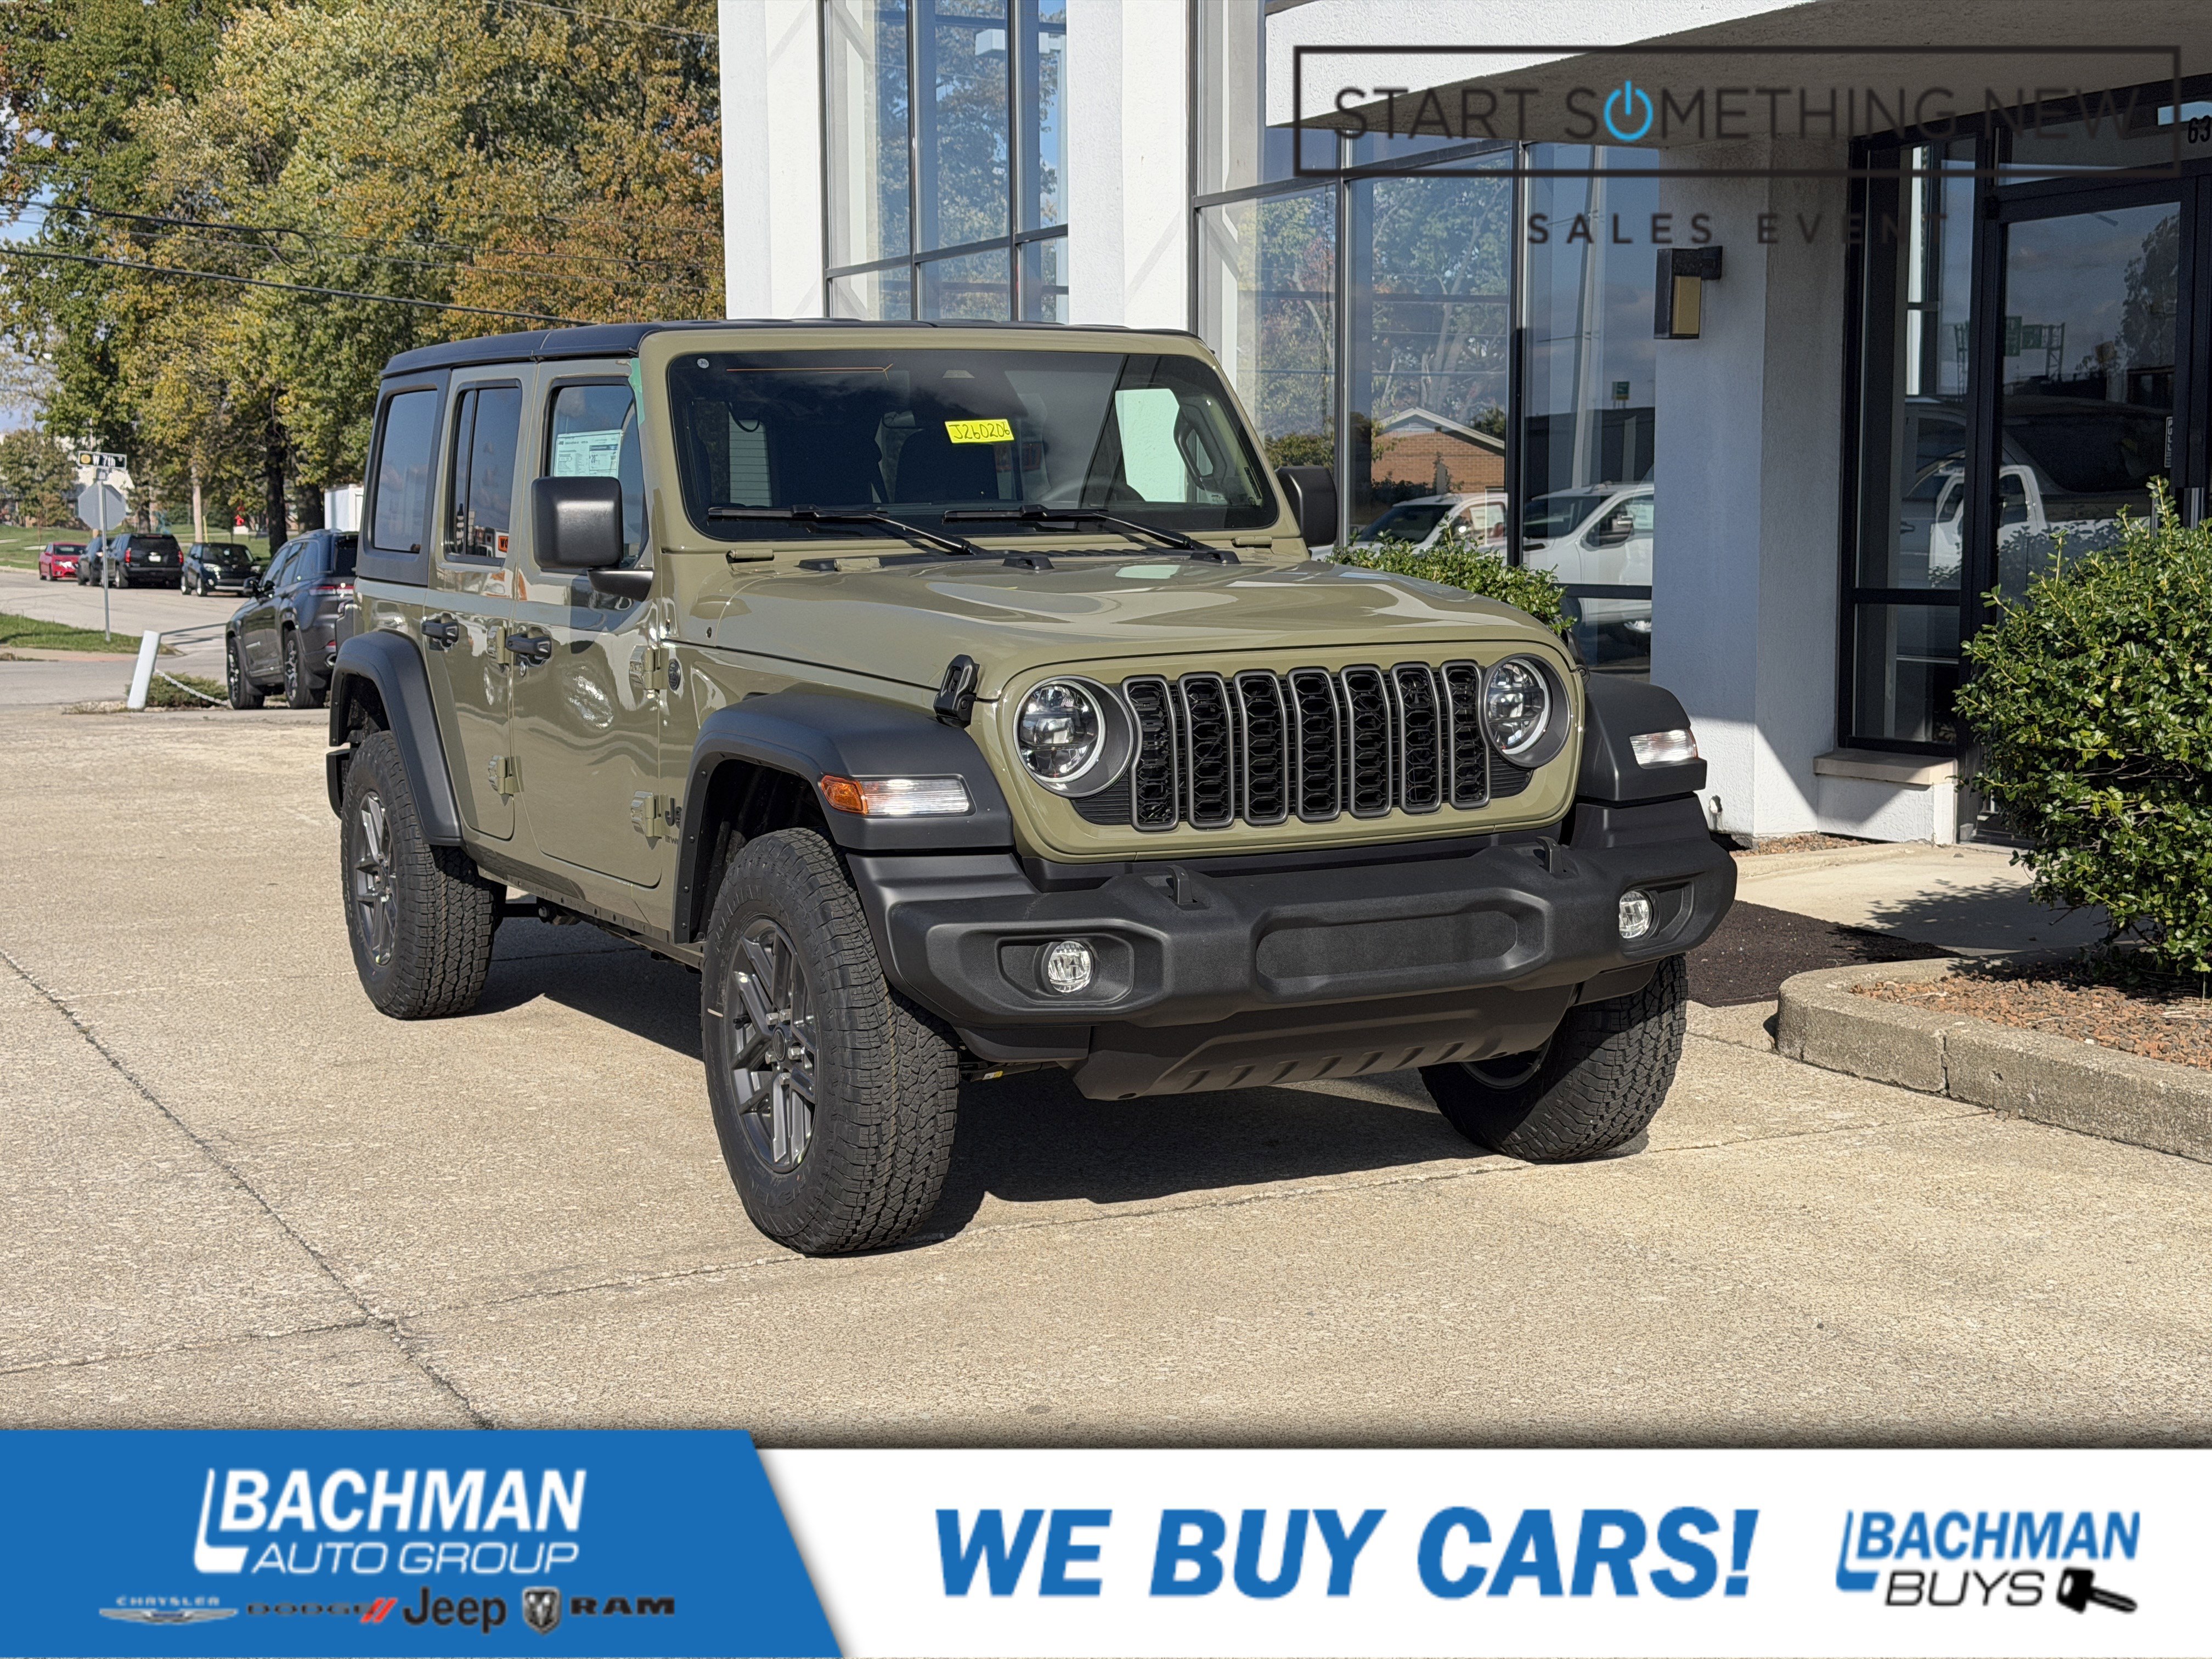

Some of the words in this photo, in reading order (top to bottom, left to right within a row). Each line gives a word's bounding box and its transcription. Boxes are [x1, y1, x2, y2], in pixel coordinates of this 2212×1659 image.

[948, 422, 1011, 440] J260206
[92, 453, 100, 466] W
[102, 454, 116, 467] 7th
